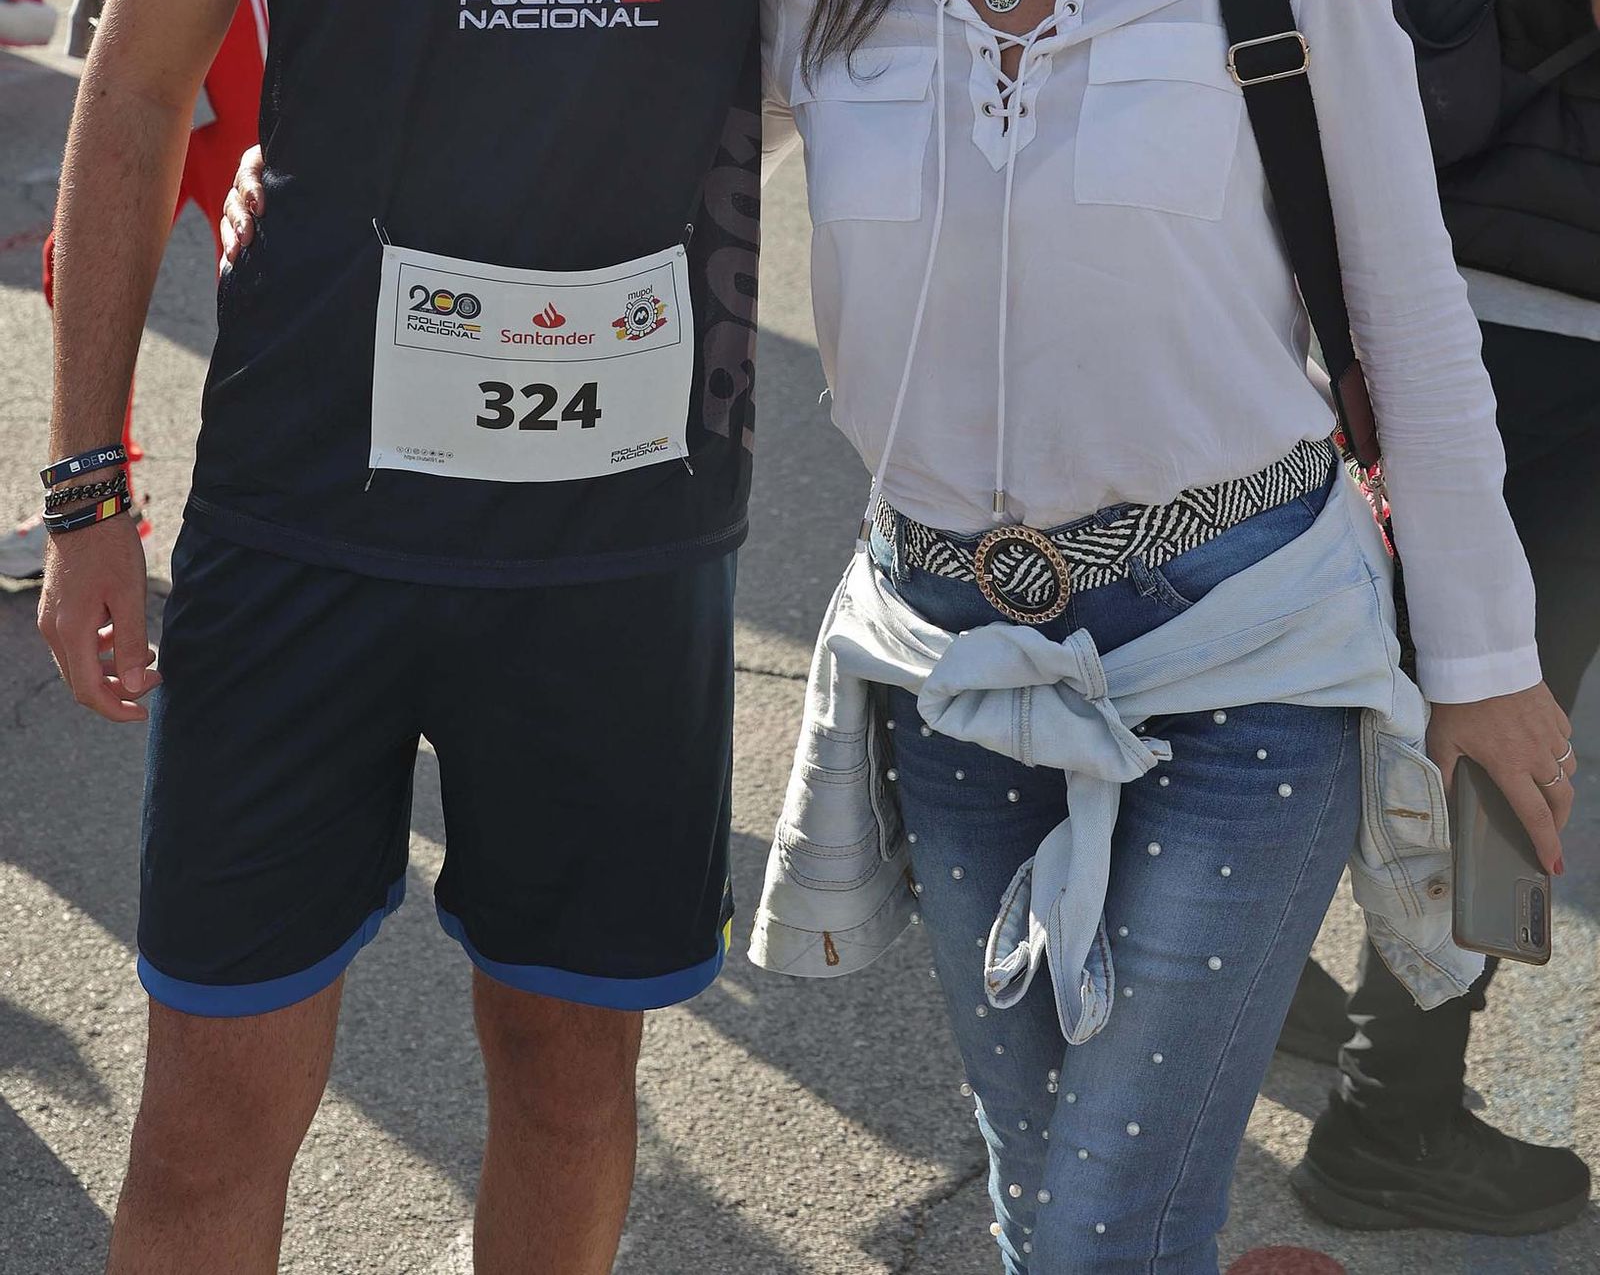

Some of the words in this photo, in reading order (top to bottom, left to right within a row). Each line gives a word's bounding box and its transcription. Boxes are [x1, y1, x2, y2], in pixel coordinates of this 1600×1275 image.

[459, 7, 659, 30] NACIONAL
[627, 284, 653, 300] mupol
[409, 284, 482, 320] 200
[407, 322, 481, 341] NACIONAL
[500, 329, 596, 346] Santander
[476, 381, 602, 431] 324
[611, 445, 668, 464] NACIONAL
